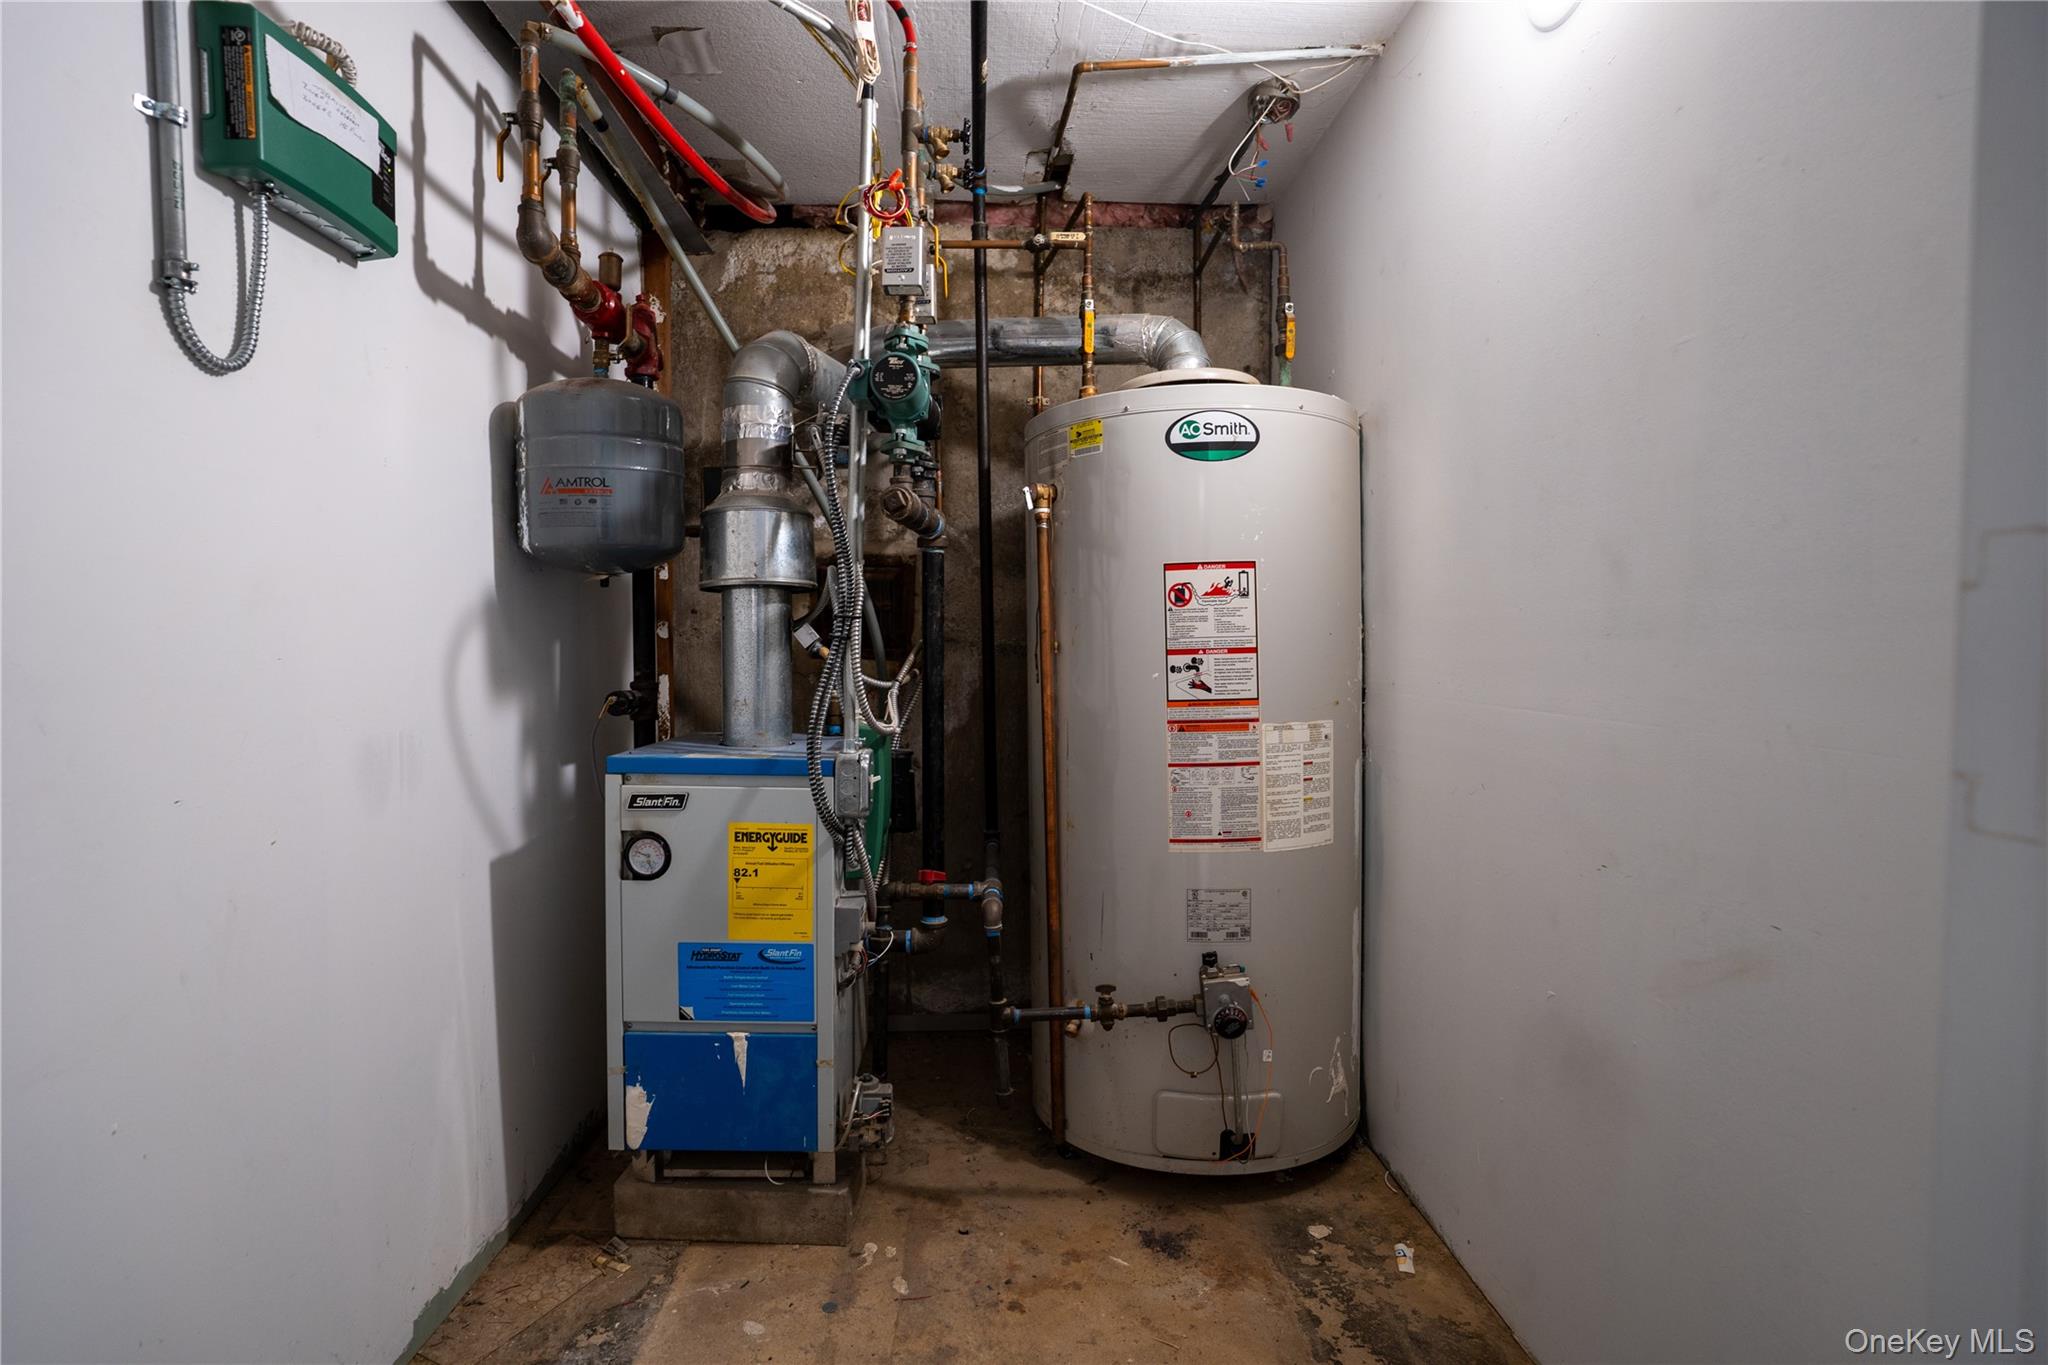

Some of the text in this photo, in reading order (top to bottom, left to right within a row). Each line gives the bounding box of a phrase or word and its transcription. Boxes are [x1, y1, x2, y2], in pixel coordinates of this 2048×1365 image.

[1203, 422, 1248, 436] Smith
[556, 477, 610, 488] AMTROL
[734, 831, 808, 845] ENERGYGUIDE
[733, 868, 759, 878] 82.1
